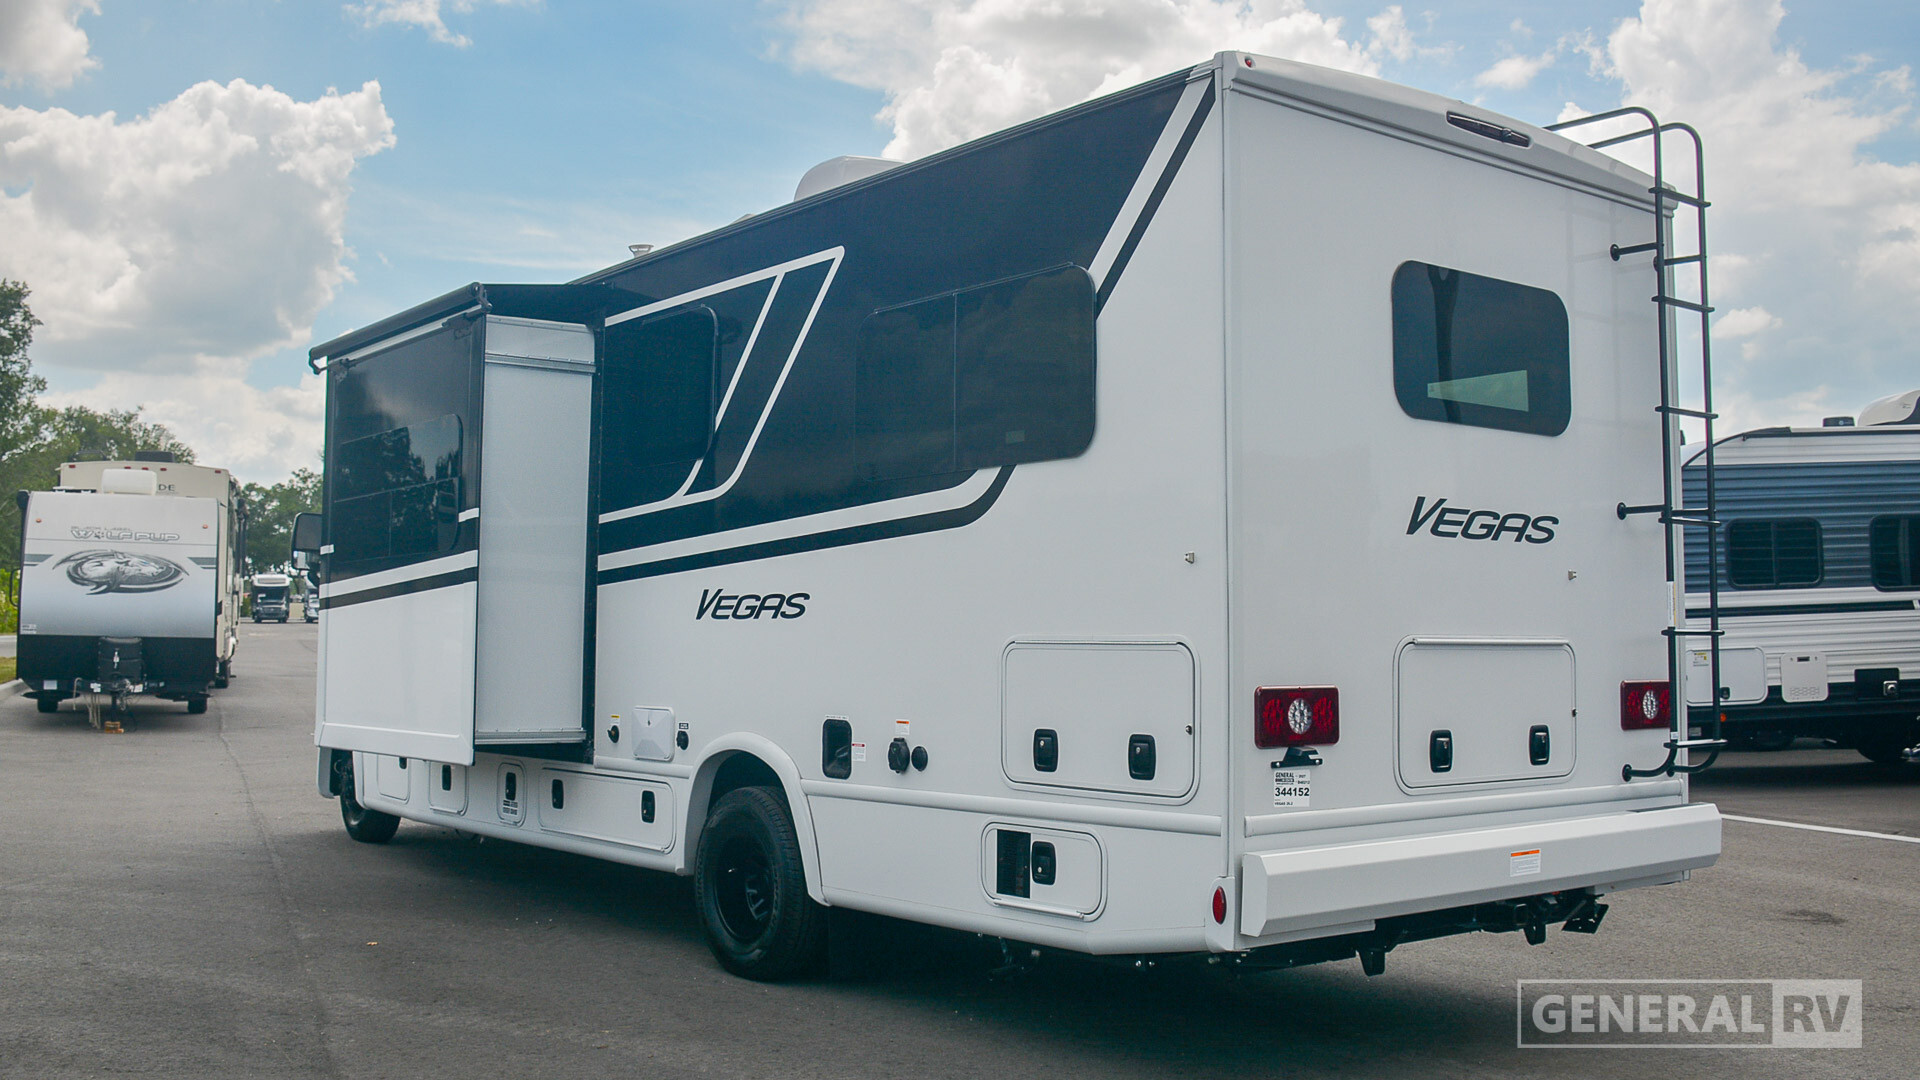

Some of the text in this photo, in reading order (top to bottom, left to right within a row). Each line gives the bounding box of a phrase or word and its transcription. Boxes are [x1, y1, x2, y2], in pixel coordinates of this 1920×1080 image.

[1406, 496, 1560, 544] VEGAS
[135, 532, 180, 541] PUP
[696, 588, 810, 620] VEGAS
[1275, 787, 1310, 797] 344152
